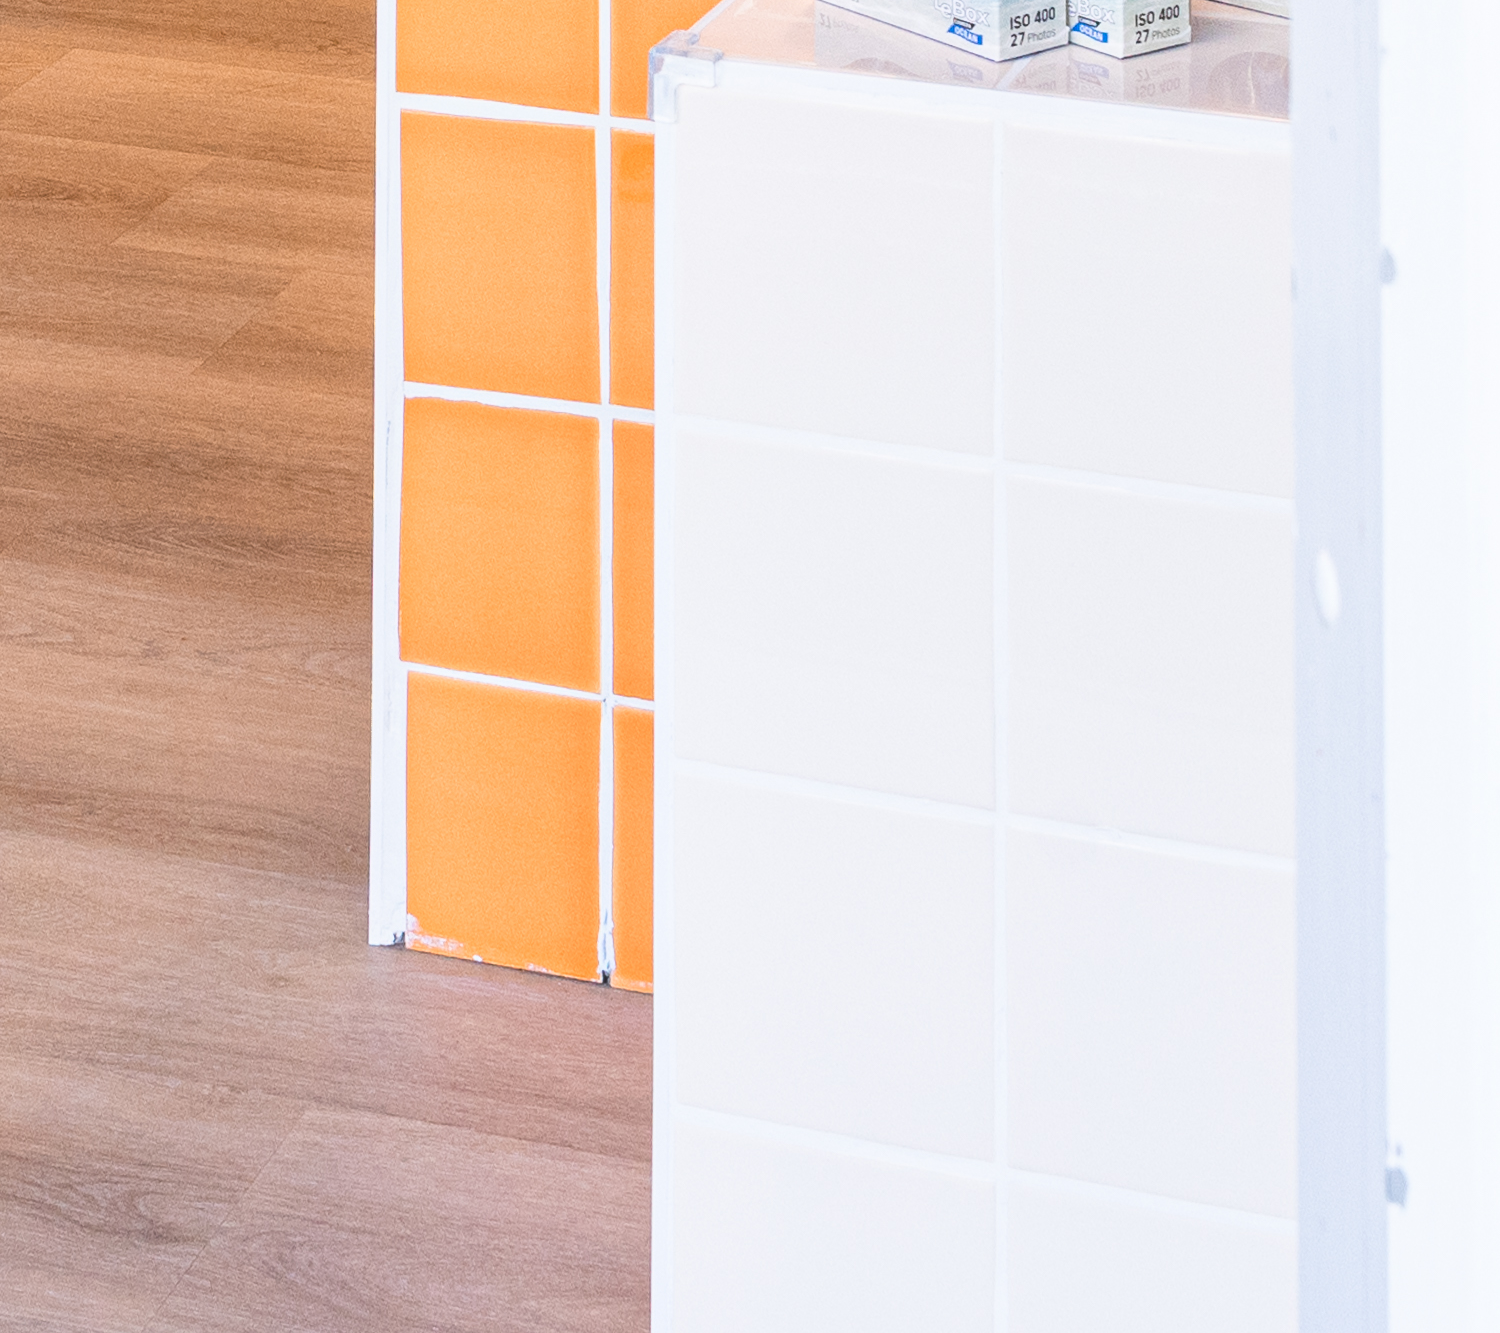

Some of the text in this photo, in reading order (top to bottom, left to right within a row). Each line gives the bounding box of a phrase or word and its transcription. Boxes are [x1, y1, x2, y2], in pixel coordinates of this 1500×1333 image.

[1009, 6, 1056, 30] ISO 400
[1135, 4, 1180, 27] ISO 400
[953, 26, 979, 44] OCEAN
[1010, 28, 1056, 47] 27 Photos
[1079, 24, 1105, 42] OCEAN
[1135, 25, 1181, 44] 27 Photos
